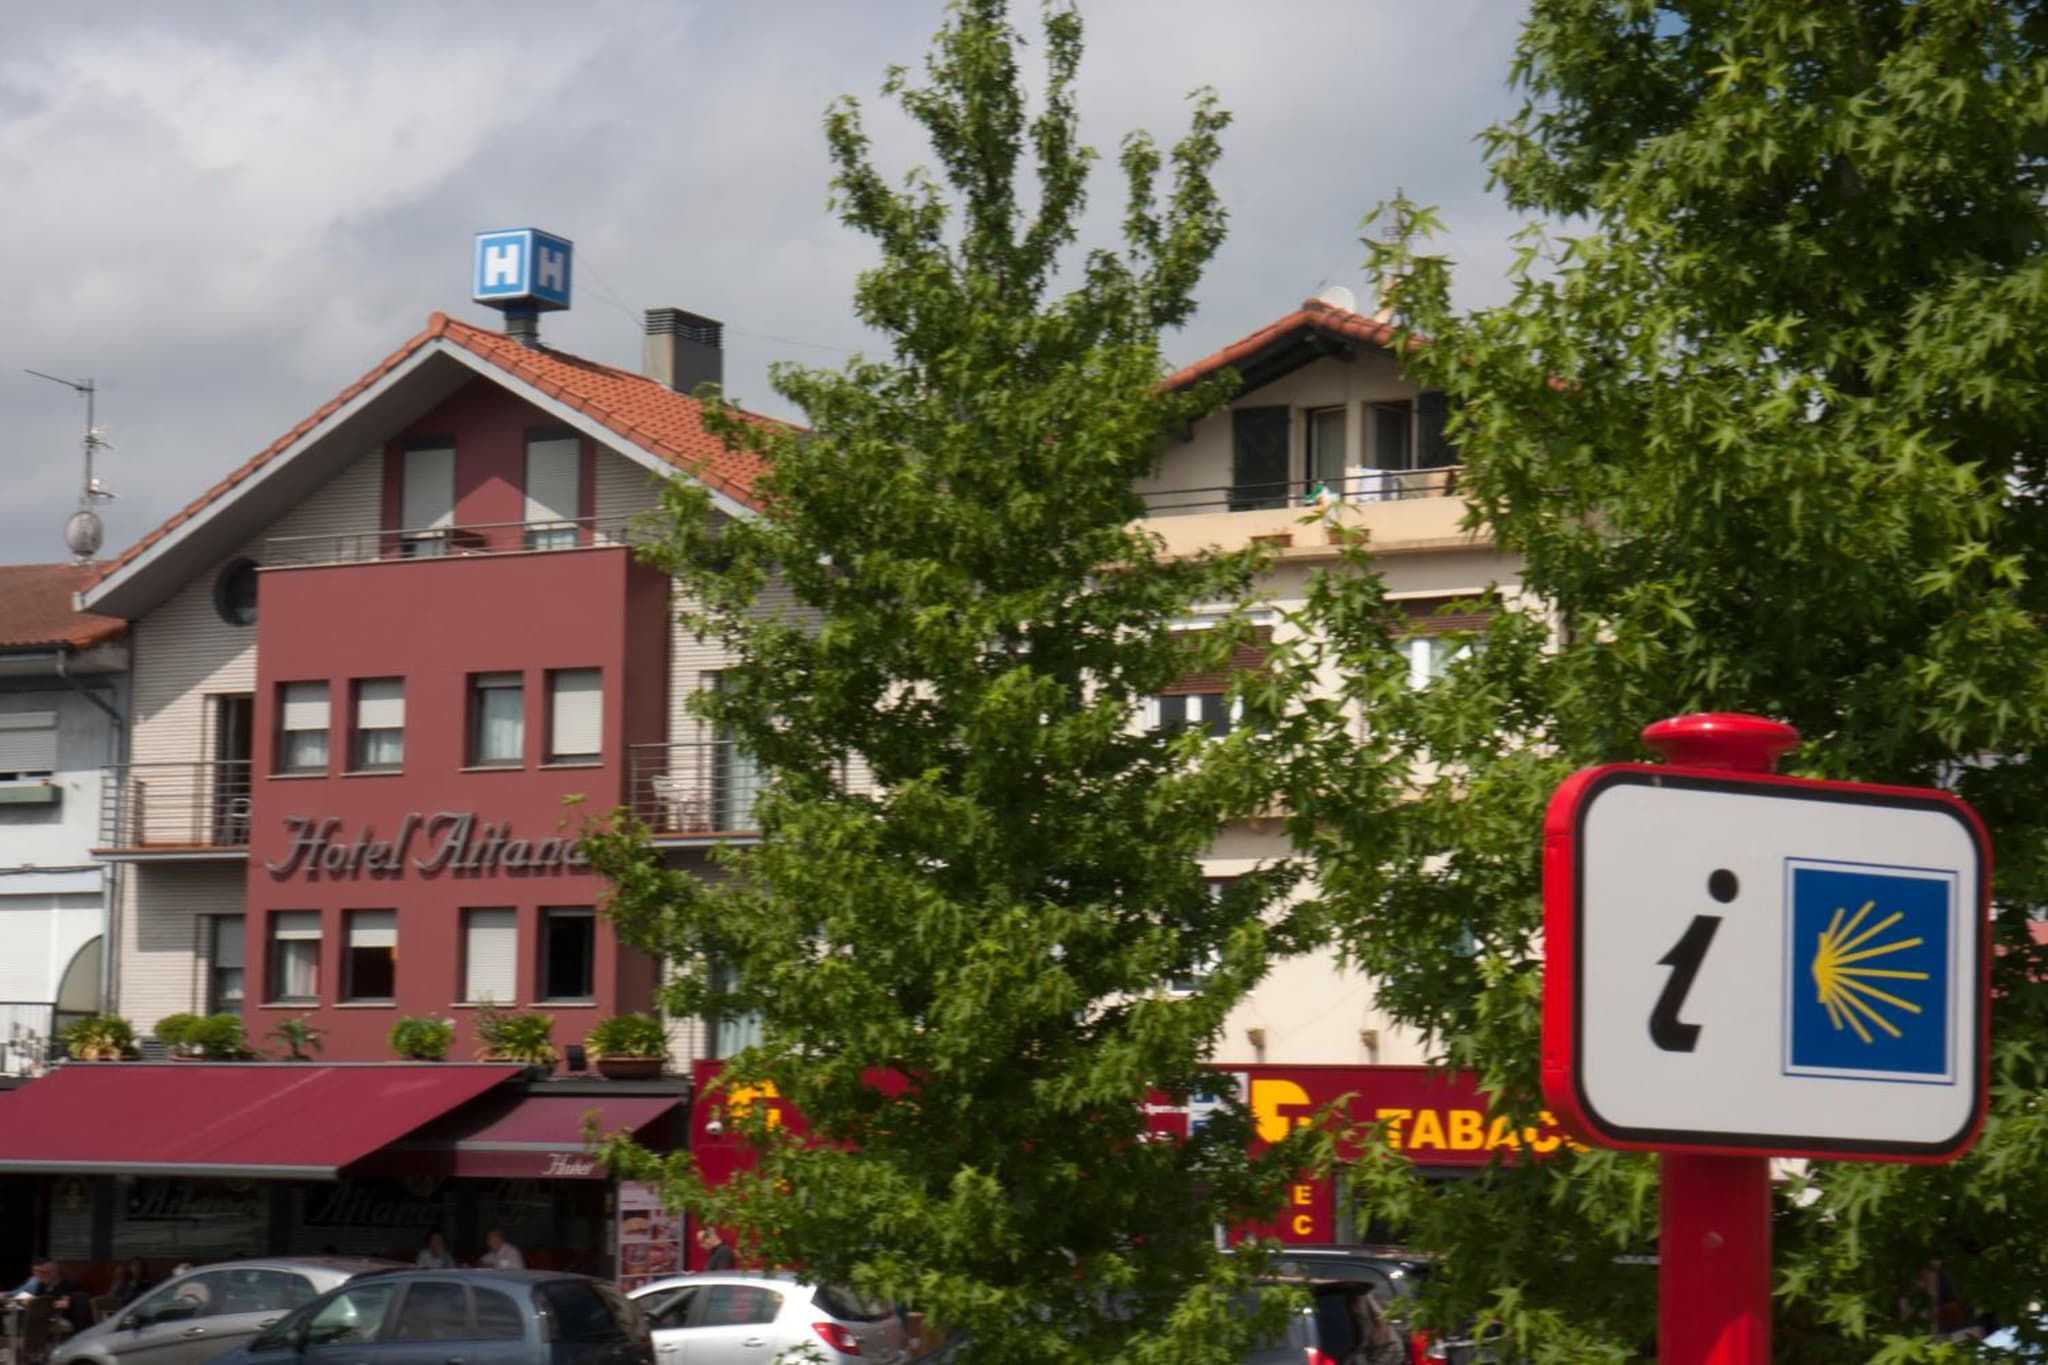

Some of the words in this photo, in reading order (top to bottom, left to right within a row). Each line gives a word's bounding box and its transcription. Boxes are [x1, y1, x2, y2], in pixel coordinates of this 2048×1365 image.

[484, 244, 519, 287] H
[538, 246, 564, 292] H
[265, 812, 421, 881] Hotel
[412, 811, 591, 879] Aitana
[1648, 868, 1739, 1053] i
